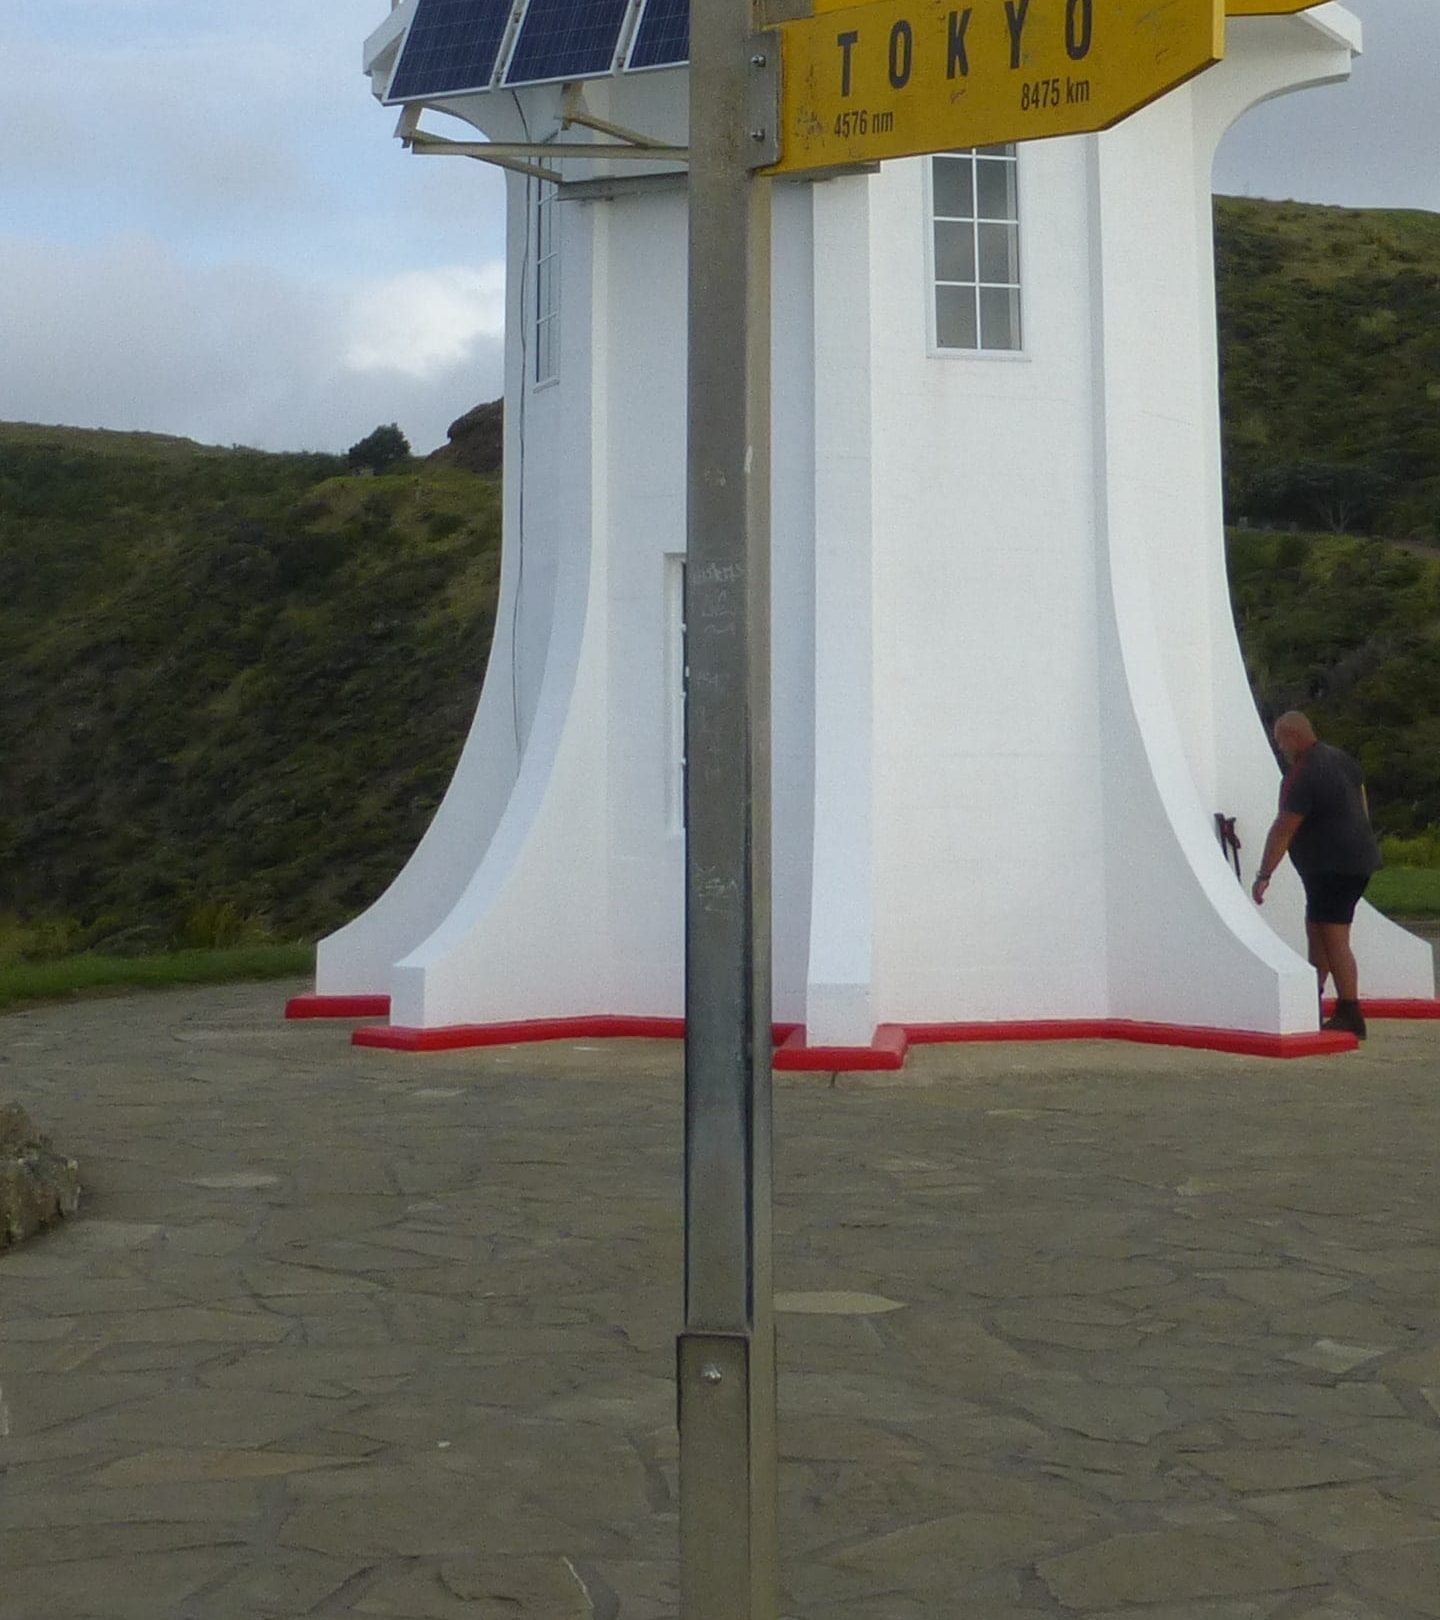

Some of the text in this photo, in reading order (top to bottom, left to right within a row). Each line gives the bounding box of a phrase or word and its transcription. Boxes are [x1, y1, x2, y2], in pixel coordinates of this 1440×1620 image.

[1021, 76, 1090, 111] 8475 km
[834, 110, 894, 139] 4576 nm
